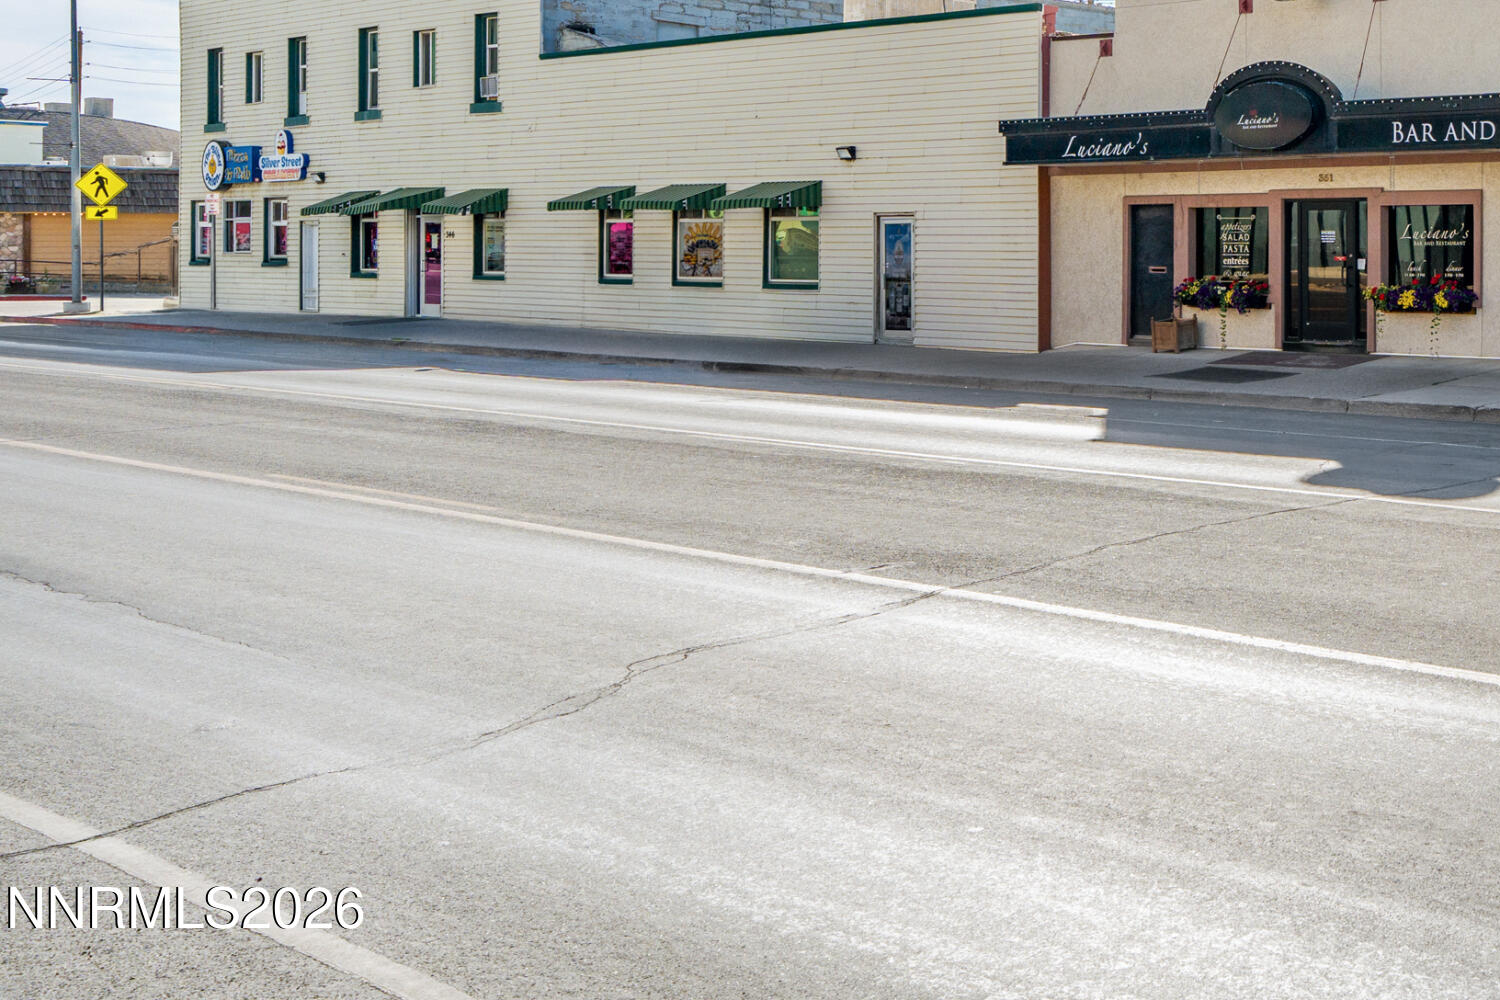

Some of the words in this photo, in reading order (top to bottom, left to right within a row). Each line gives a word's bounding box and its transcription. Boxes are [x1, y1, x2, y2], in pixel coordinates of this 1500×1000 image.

[1236, 112, 1280, 125] Luciano's
[1392, 121, 1437, 144] BAR
[1443, 121, 1496, 142] AND
[1062, 132, 1149, 158] Luciano's
[261, 157, 281, 169] Silver
[281, 156, 302, 168] Street
[1318, 173, 1333, 182] 351
[1222, 233, 1250, 241] SALAD
[1400, 222, 1470, 239] Luciano's
[1222, 244, 1250, 253] PASTA
[1222, 255, 1250, 265] entrées
